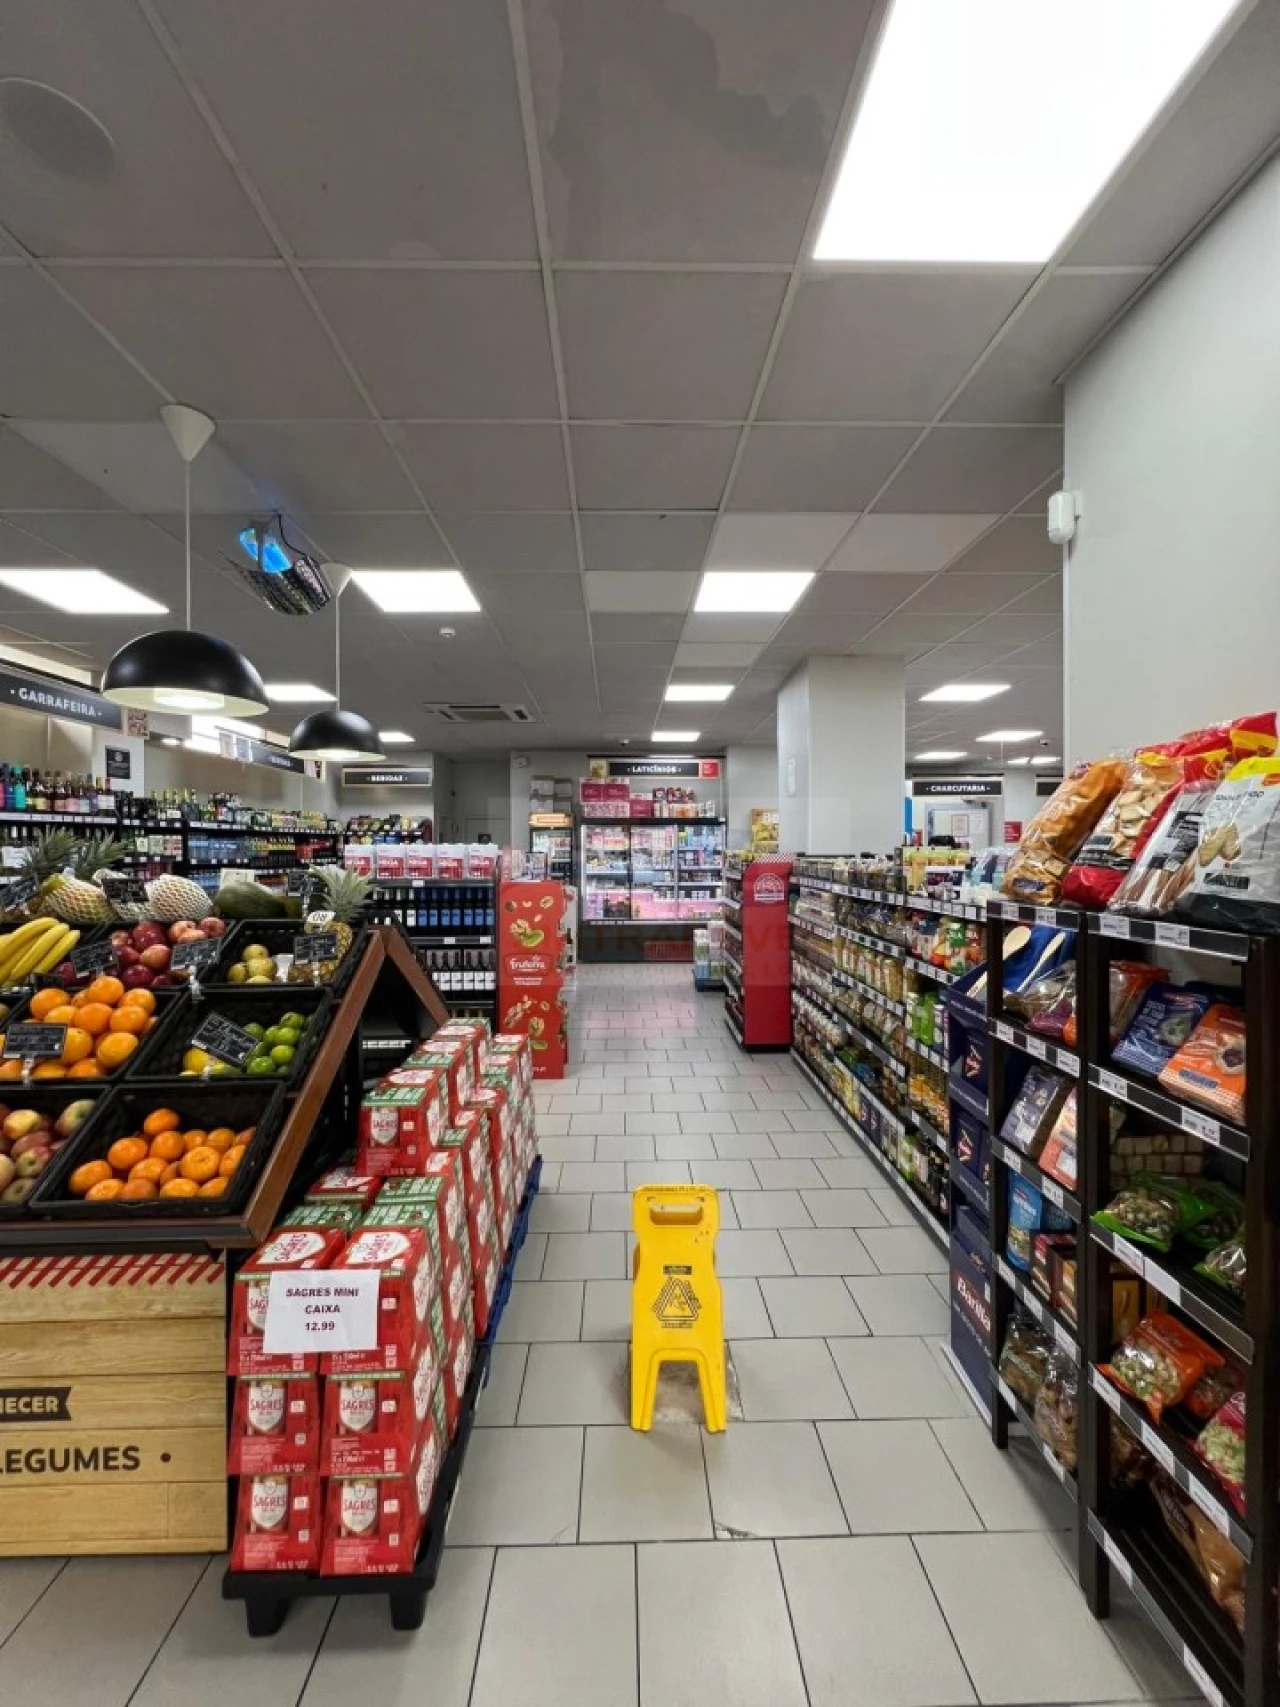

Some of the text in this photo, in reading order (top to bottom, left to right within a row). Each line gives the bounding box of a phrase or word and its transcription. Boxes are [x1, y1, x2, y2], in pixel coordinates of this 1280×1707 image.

[19, 687, 96, 717] GARRAFEIRA
[632, 765, 677, 774] LATICÍNIOS
[286, 1286, 359, 1297] SAGRES MINI
[305, 1304, 341, 1315] CAIXA
[304, 1320, 336, 1331] 12.99
[250, 1399, 283, 1412] SAGRES
[341, 1399, 375, 1412] SAGRES
[0, 1446, 141, 1474] EGUMES
[253, 1495, 285, 1508] SAGRES
[344, 1499, 376, 1512] SAGRES
